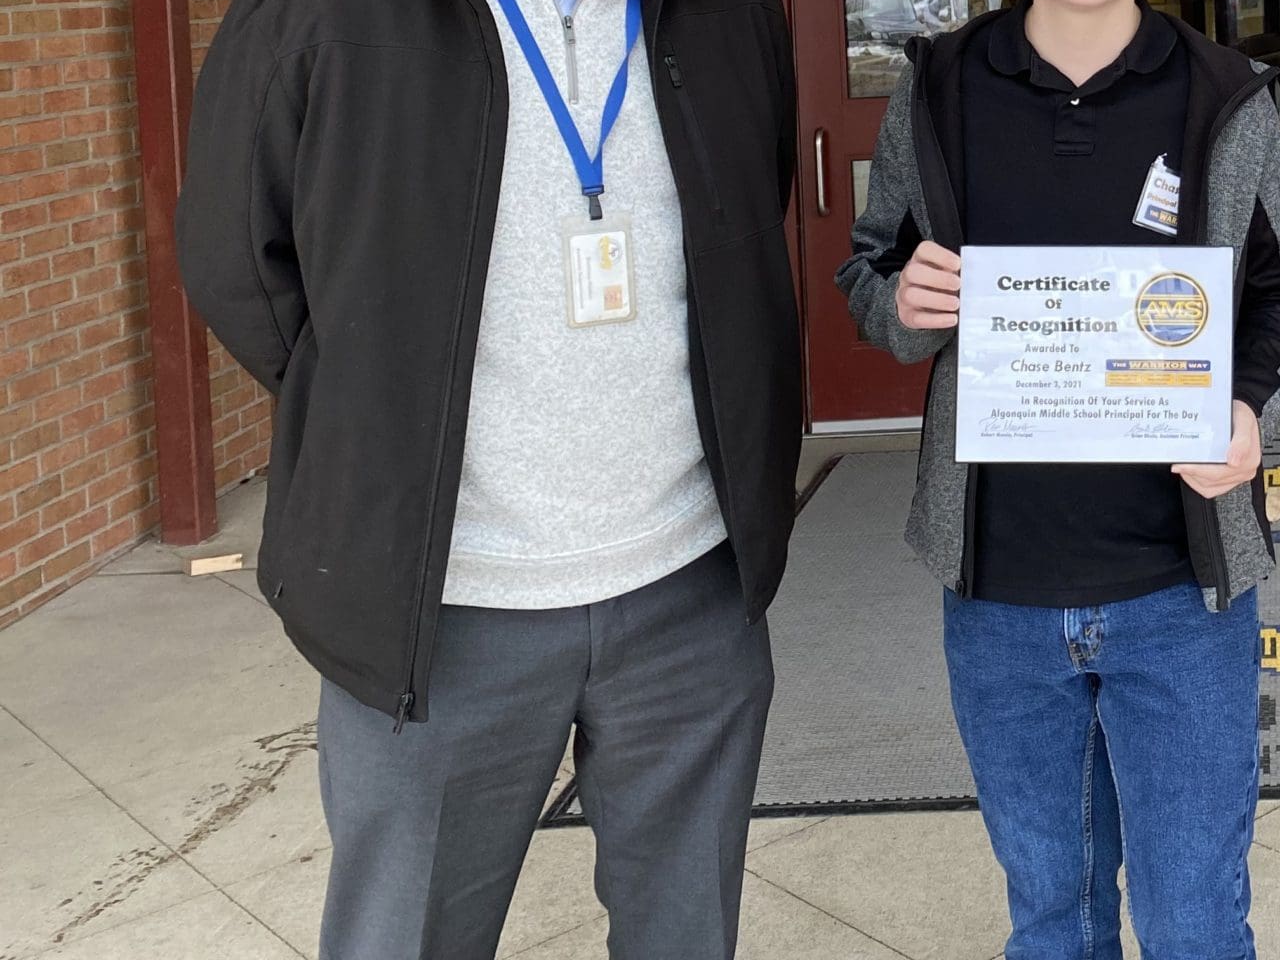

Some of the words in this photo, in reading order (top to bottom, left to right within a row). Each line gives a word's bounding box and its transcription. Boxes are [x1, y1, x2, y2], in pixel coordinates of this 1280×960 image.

[1160, 211, 1178, 226] WAR
[997, 275, 1111, 291] Certificate
[1045, 298, 1063, 309] Of
[1141, 300, 1203, 319] AMS
[991, 316, 1118, 336] Recognition
[1025, 343, 1066, 353] Awarded
[1069, 343, 1080, 353] To
[1010, 358, 1050, 372] Chase
[1054, 359, 1092, 372] Bentz
[1015, 380, 1052, 388] December
[1021, 395, 1031, 405] In
[1033, 396, 1085, 406] Recognition
[1088, 396, 1098, 405] Of
[1101, 396, 1121, 406] Your
[1124, 397, 1156, 406] Service
[1158, 397, 1169, 406] As
[991, 408, 1037, 420] Algonquin
[1039, 408, 1070, 418] Middle
[1073, 409, 1101, 418] School
[1104, 410, 1144, 420] Principal
[1147, 410, 1160, 419] For
[1163, 410, 1179, 419] The
[1182, 410, 1199, 421] Day
